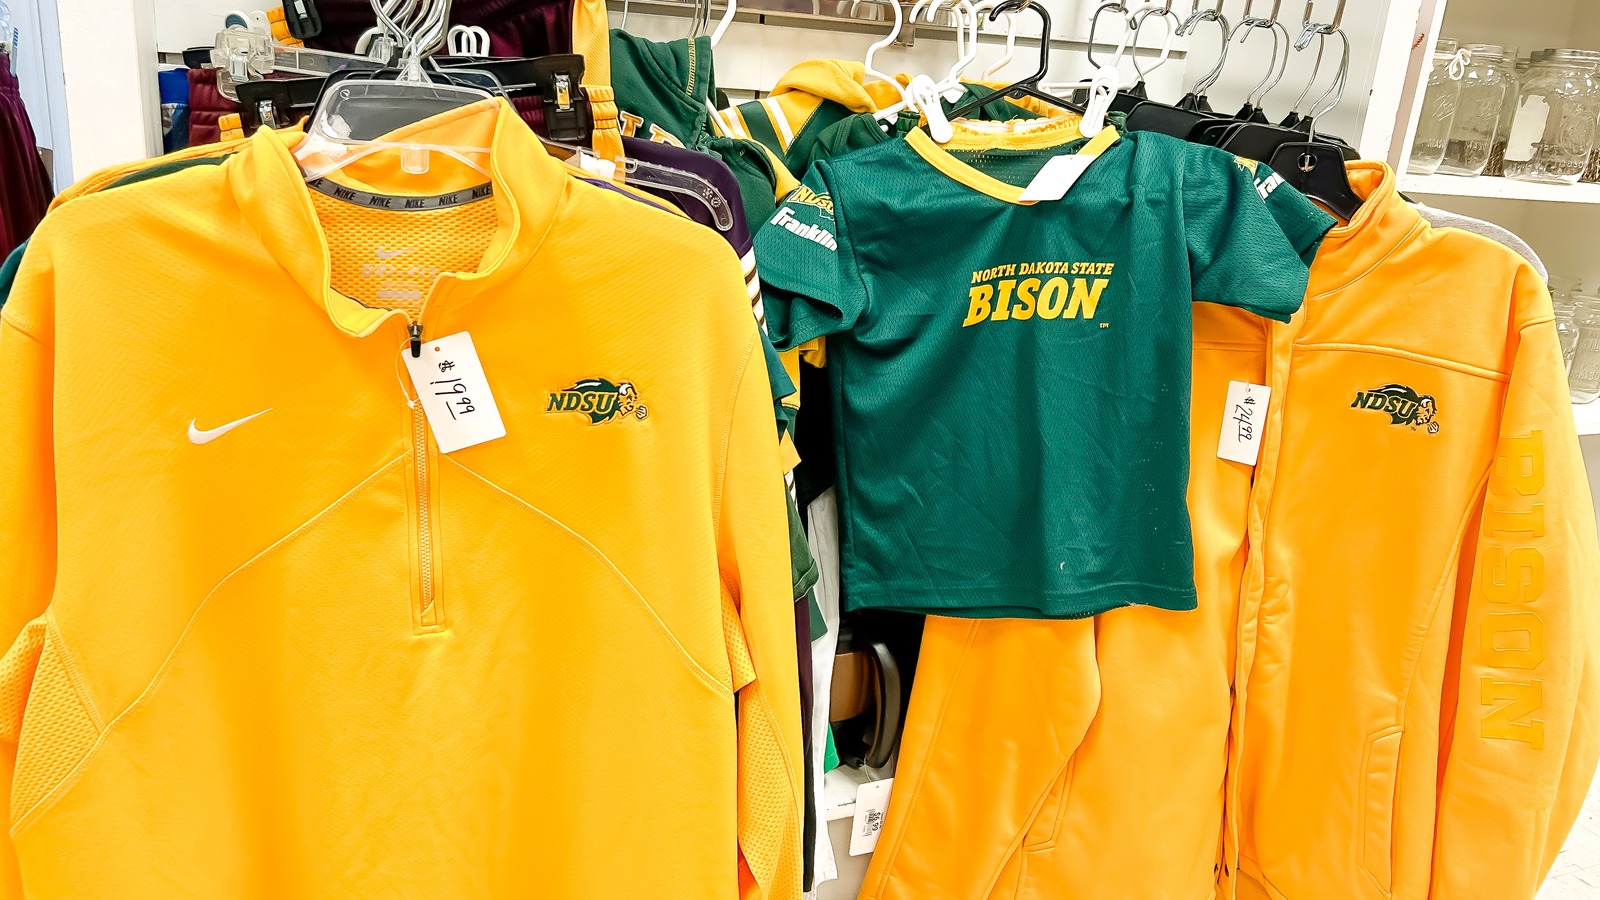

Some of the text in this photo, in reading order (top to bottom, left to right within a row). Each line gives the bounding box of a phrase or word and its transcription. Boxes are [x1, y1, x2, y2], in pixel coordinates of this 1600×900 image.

[308, 178, 491, 208] KE NIKE NIKE NIKE NIKE NIKE
[770, 206, 838, 252] Franklin
[971, 261, 1115, 284] NORTH DAKOTA STATE
[962, 276, 1110, 328] BISON
[546, 392, 615, 412] NDSU
[1350, 391, 1417, 417] NDSU
[1480, 429, 1545, 750] BISON
